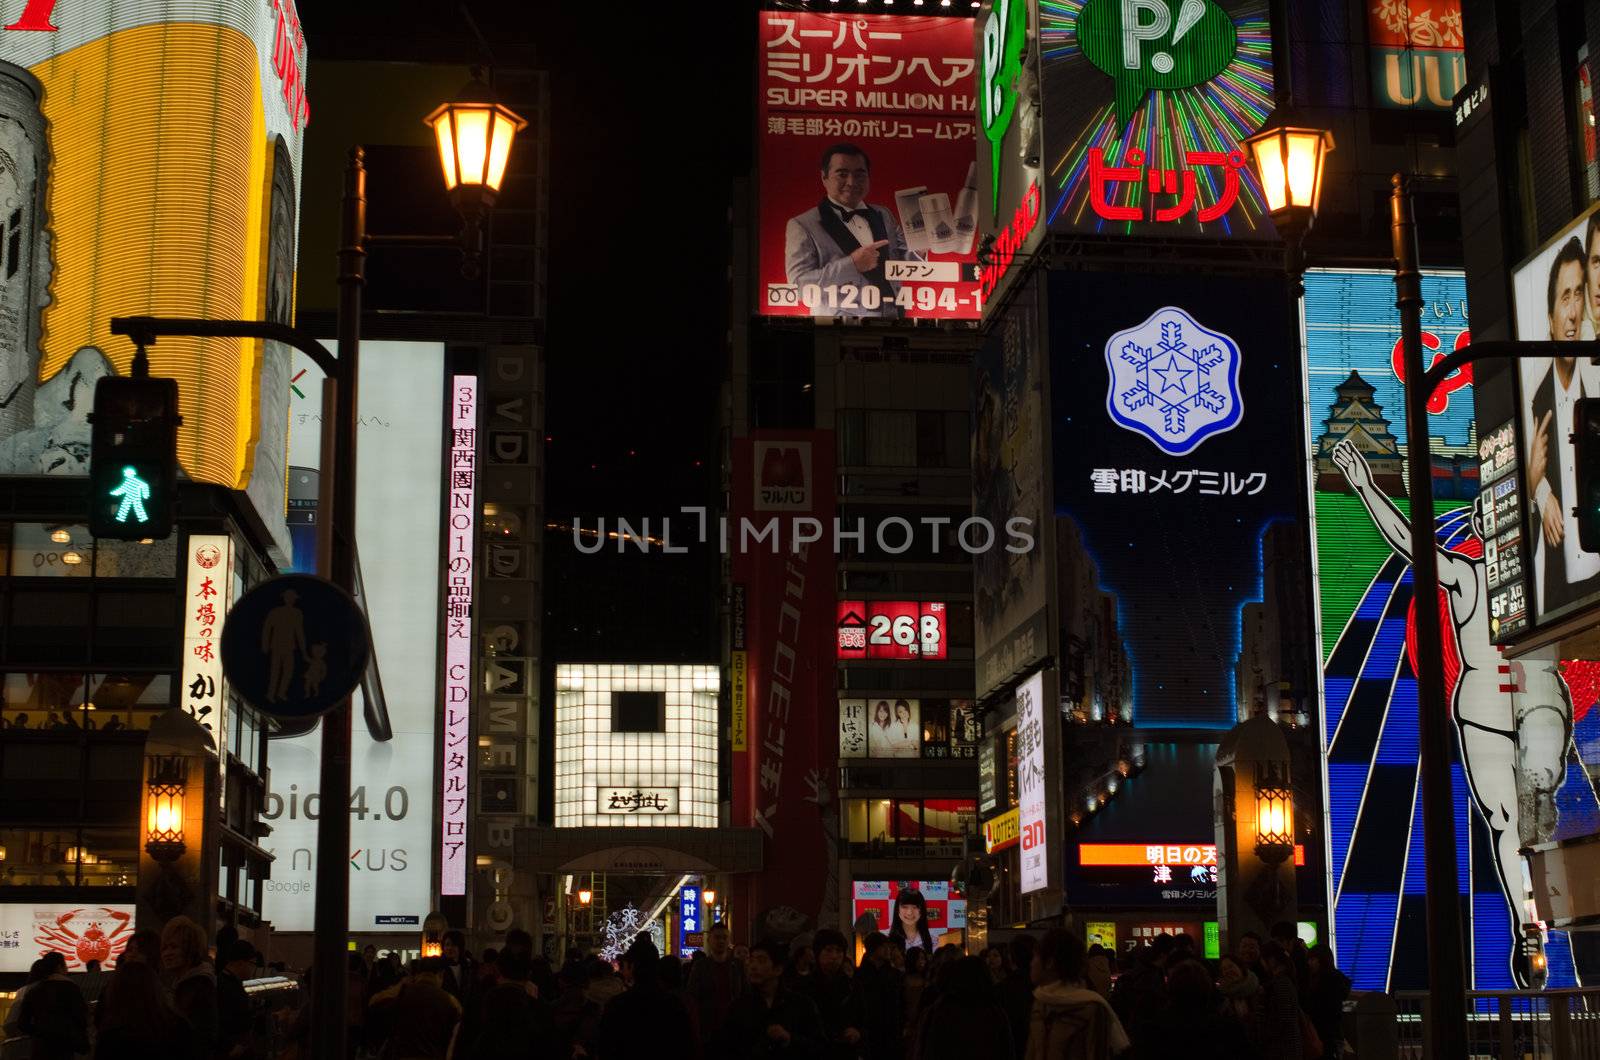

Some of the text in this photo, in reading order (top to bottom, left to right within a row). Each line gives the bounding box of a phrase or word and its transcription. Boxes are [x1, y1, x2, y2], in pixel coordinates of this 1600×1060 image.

[767, 18, 902, 50] スーパー
[767, 87, 848, 107] SUPER
[856, 91, 944, 110] MILLION
[1088, 147, 1246, 223] ピップ
[890, 264, 934, 277] ルアン
[801, 284, 982, 312] 0120-494-1
[457, 386, 473, 420] 3F
[1090, 468, 1267, 495] 雪印メグミルク
[761, 490, 804, 503] マルハン
[194, 576, 217, 663] 本場の味
[445, 664, 468, 860] CDレンタルフロア
[1022, 819, 1045, 851] an
[265, 880, 311, 895] Google
[1153, 865, 1173, 883] 津
